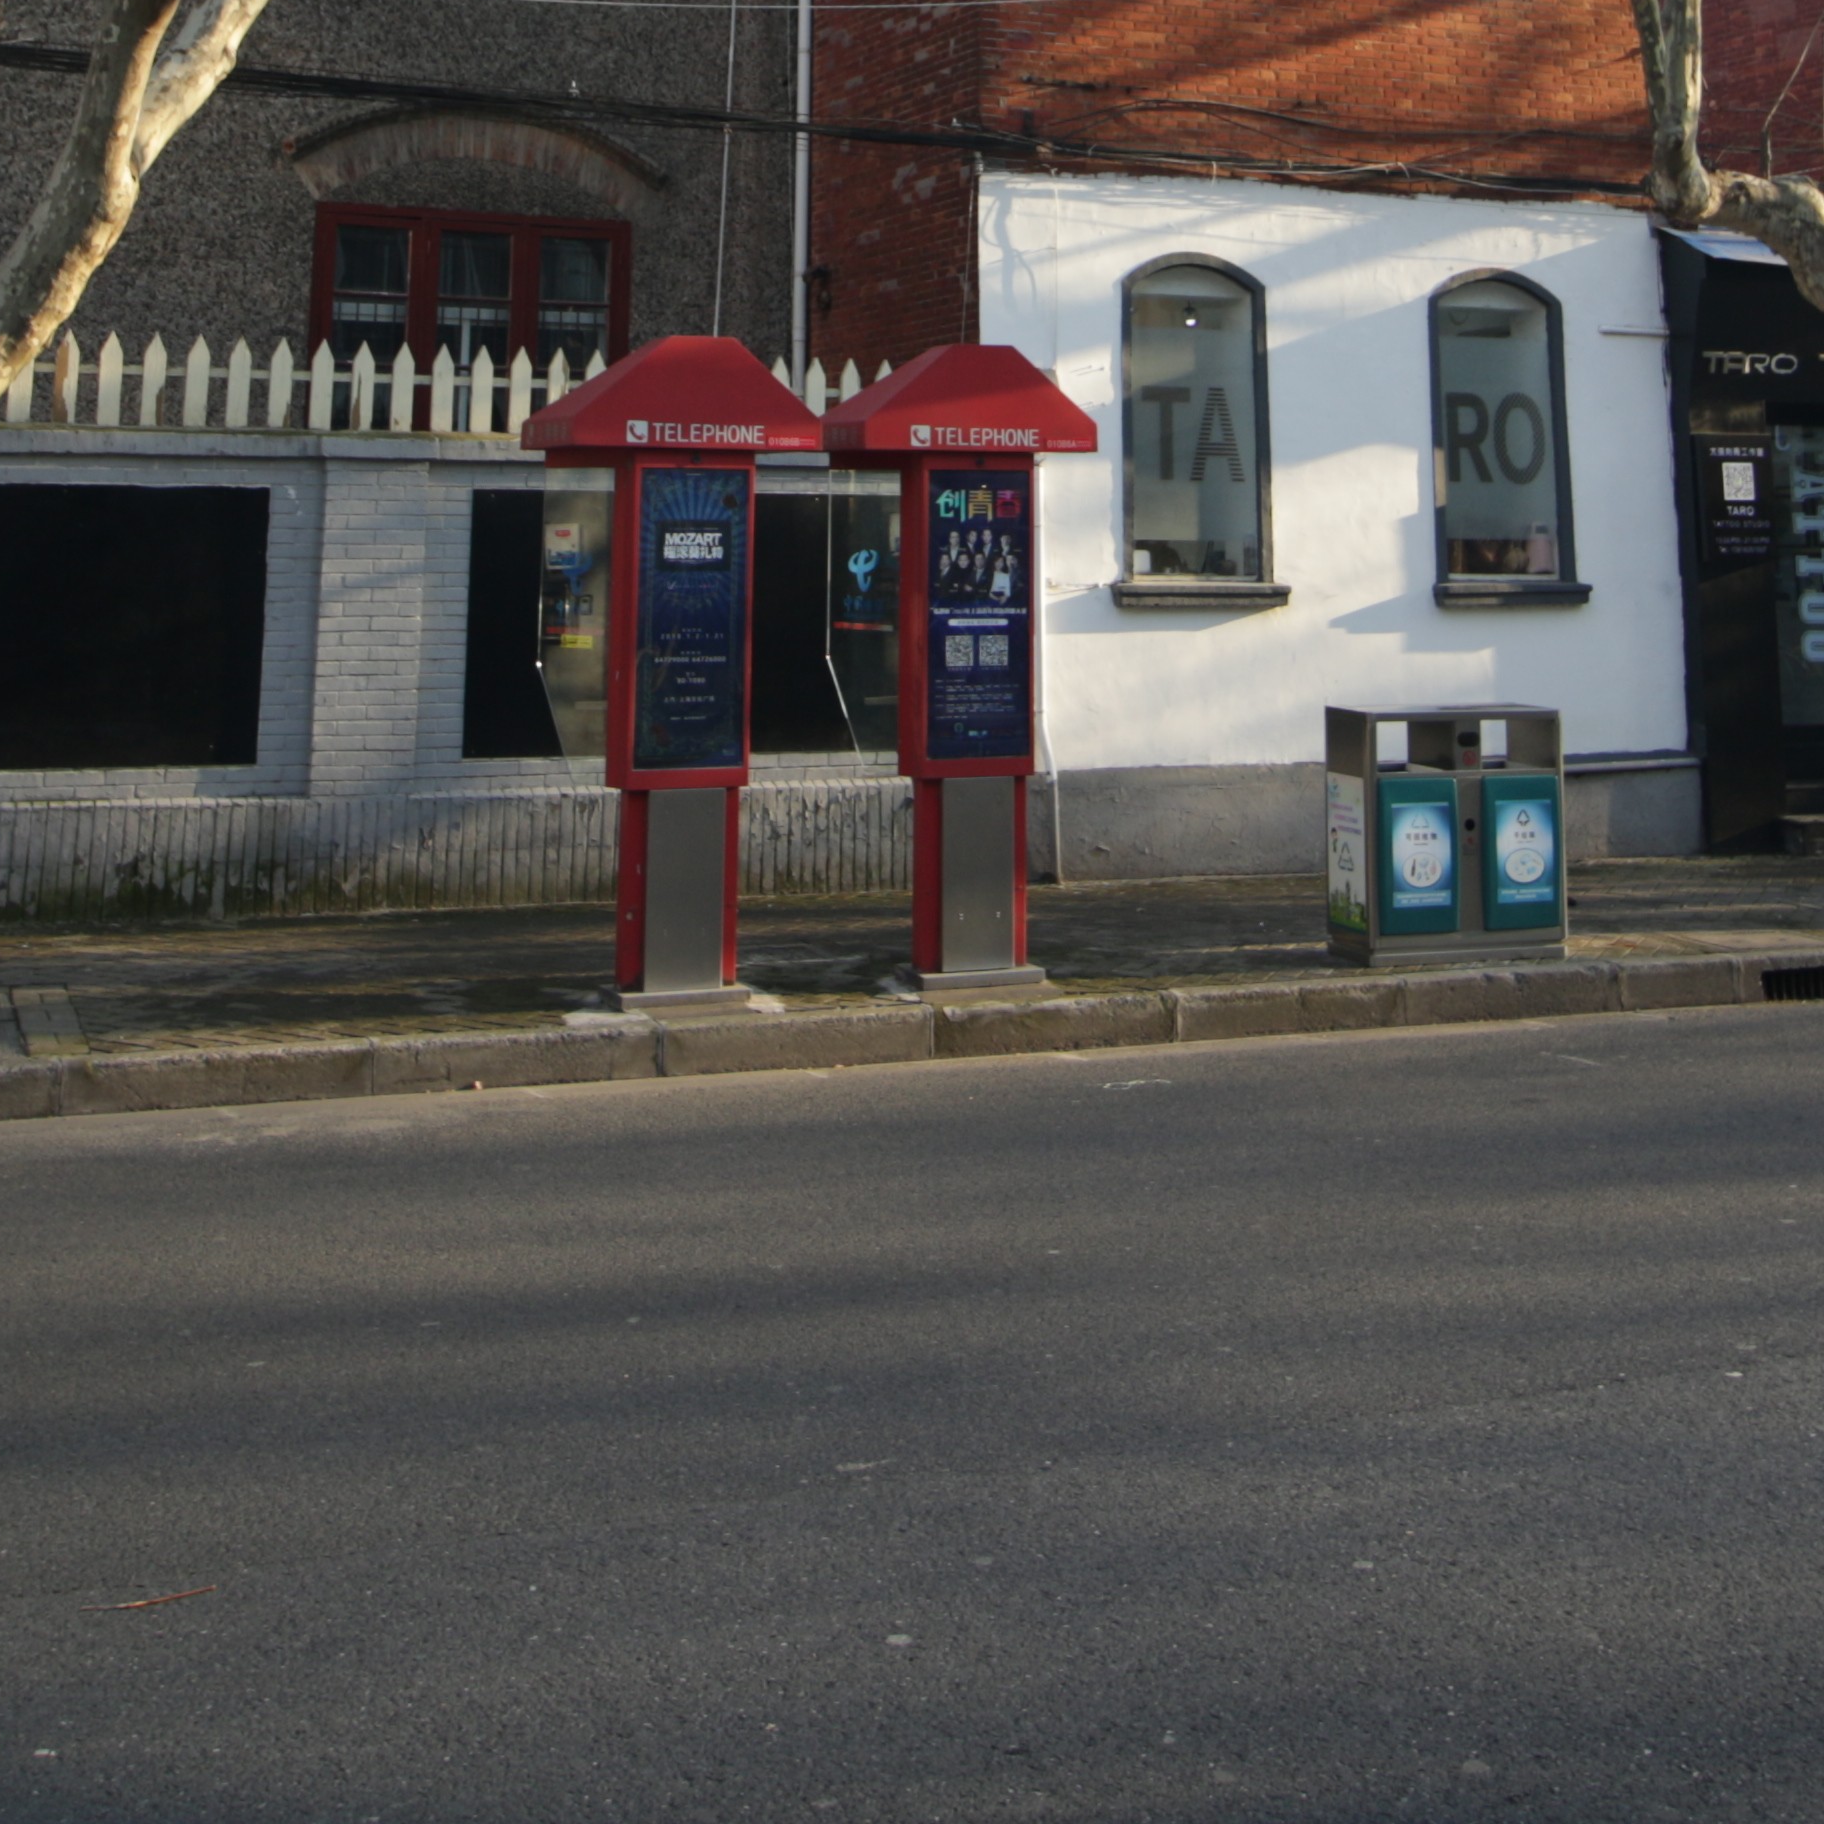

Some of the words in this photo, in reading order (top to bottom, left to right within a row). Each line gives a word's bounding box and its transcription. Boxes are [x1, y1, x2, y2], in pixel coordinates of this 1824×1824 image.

[1702, 351, 1798, 375] TARO
[652, 422, 765, 445] TELEPHONE
[934, 426, 1040, 447] TELEPHONE
[1140, 385, 1246, 483] TA
[1445, 391, 1546, 485] RO
[1726, 505, 1755, 516] TARO
[664, 532, 723, 546] MOZART
